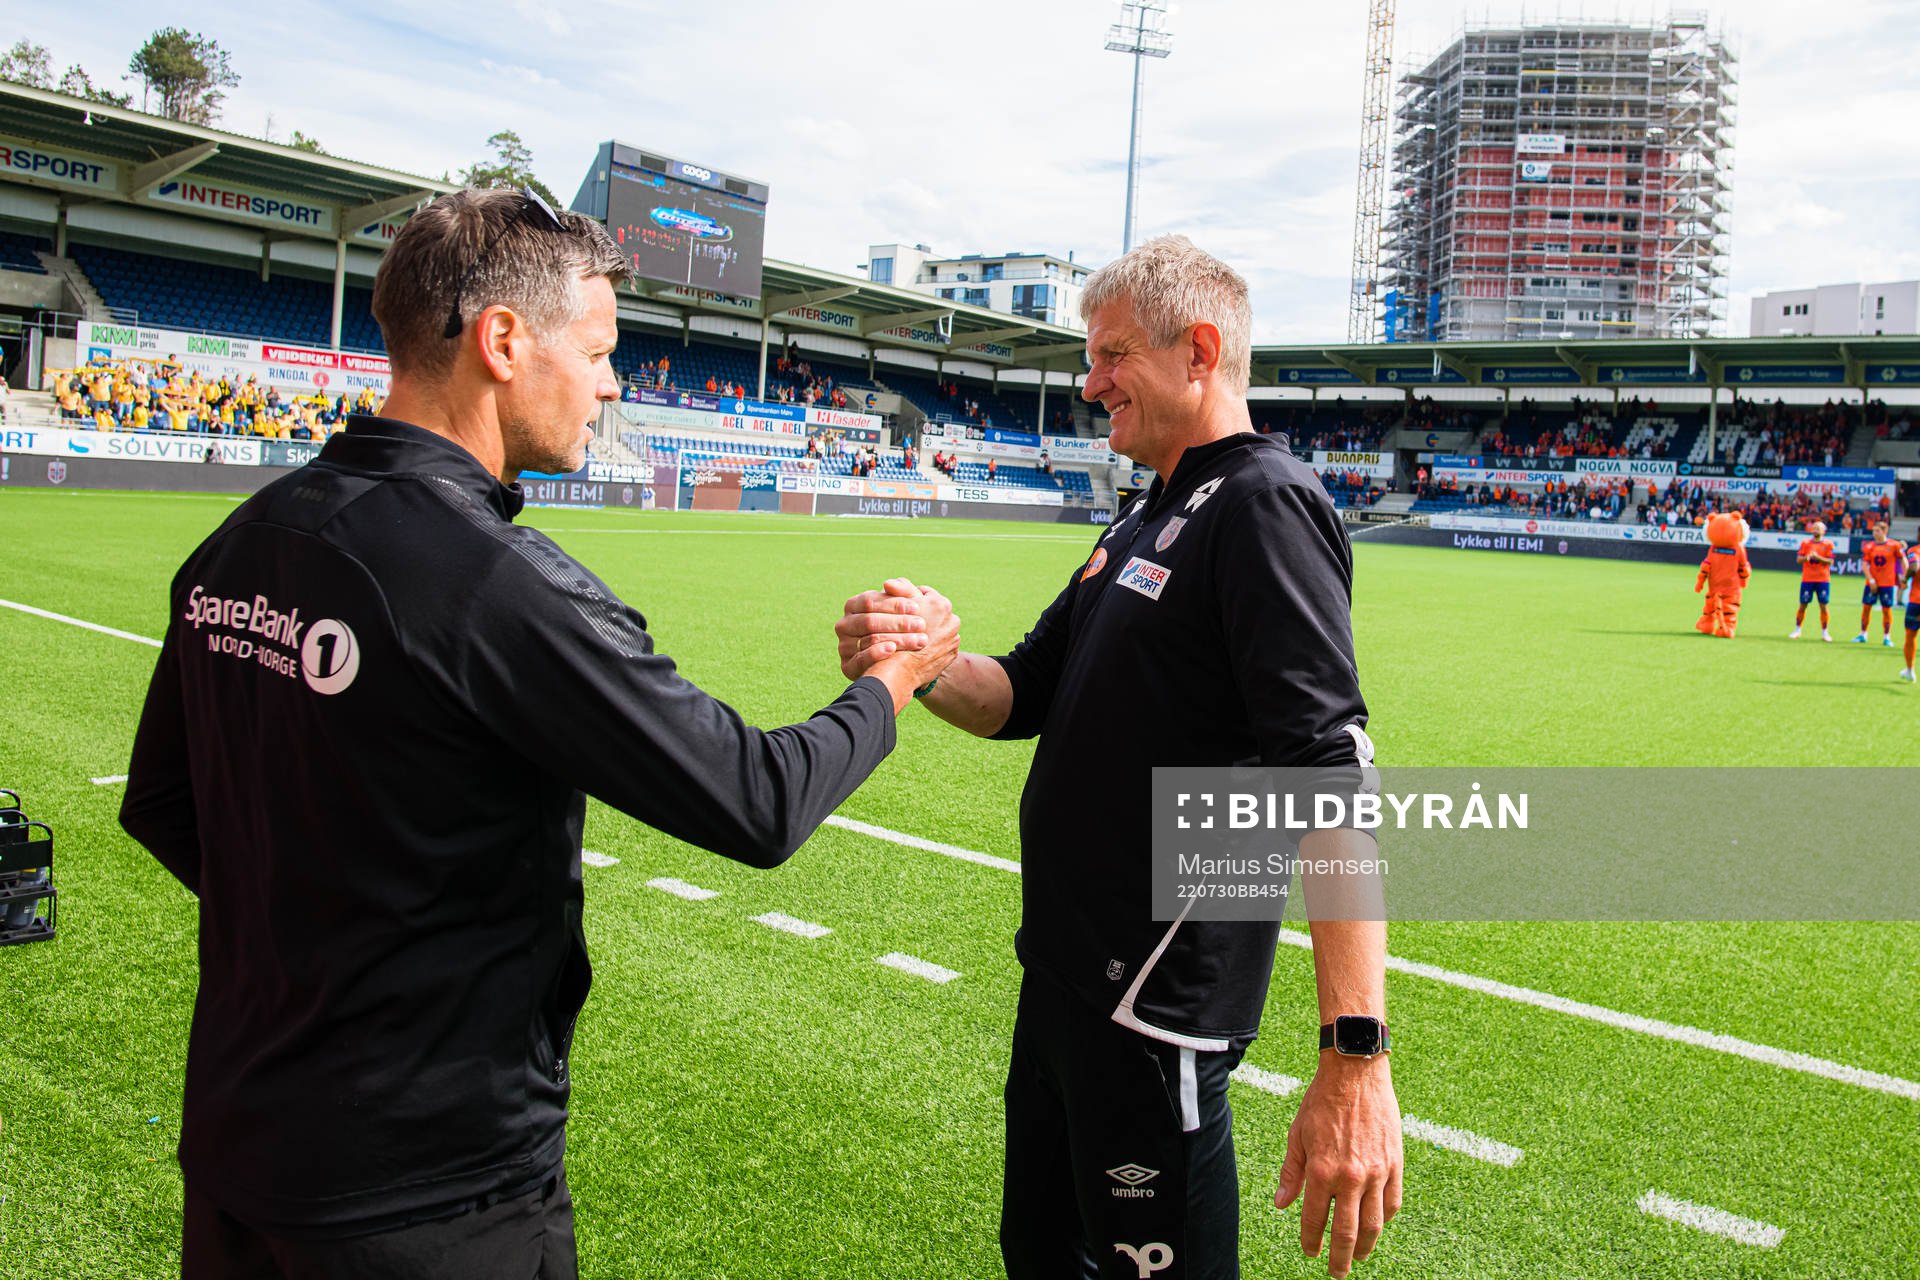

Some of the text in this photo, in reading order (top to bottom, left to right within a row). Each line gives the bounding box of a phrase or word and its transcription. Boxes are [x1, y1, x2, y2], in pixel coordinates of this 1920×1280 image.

[682, 164, 711, 181] coop
[182, 182, 322, 225] INTERSPORT
[91, 325, 137, 346] KIWI
[140, 331, 159, 340] mini
[139, 340, 156, 349] pris
[187, 336, 230, 356] KIWI
[231, 342, 249, 350] mini
[231, 349, 247, 359] pris
[268, 349, 333, 366] VEIDEKKE
[268, 367, 310, 381] RINGDAL
[346, 375, 384, 389] RINGDAL
[723, 416, 744, 429] ACEL
[753, 419, 773, 432] ACEL
[782, 421, 802, 434] ACEL
[832, 413, 871, 427] fasader
[1054, 439, 1107, 450] Bunker Oil
[1327, 452, 1381, 464] BUNNPRIS
[1579, 460, 1674, 473] NOGVA NOGVA
[1495, 471, 1563, 483] INTERSPORT
[538, 482, 555, 499] til
[570, 483, 604, 501] EM!
[1690, 478, 1768, 492] INTERSPORT
[1800, 483, 1884, 495] INTERSPORT
[956, 488, 989, 500] TESS
[859, 500, 890, 515] Lykke
[911, 502, 931, 514] EM!
[1454, 533, 1490, 549] Lykke
[1494, 535, 1507, 548] til
[1518, 537, 1544, 551] EM!
[1138, 563, 1166, 583] INTER
[1130, 574, 1160, 593] SPORT
[184, 585, 338, 676] SpareBank 1
[208, 634, 297, 679] NORD-NORGE
[1111, 1186, 1155, 1198] umbro
